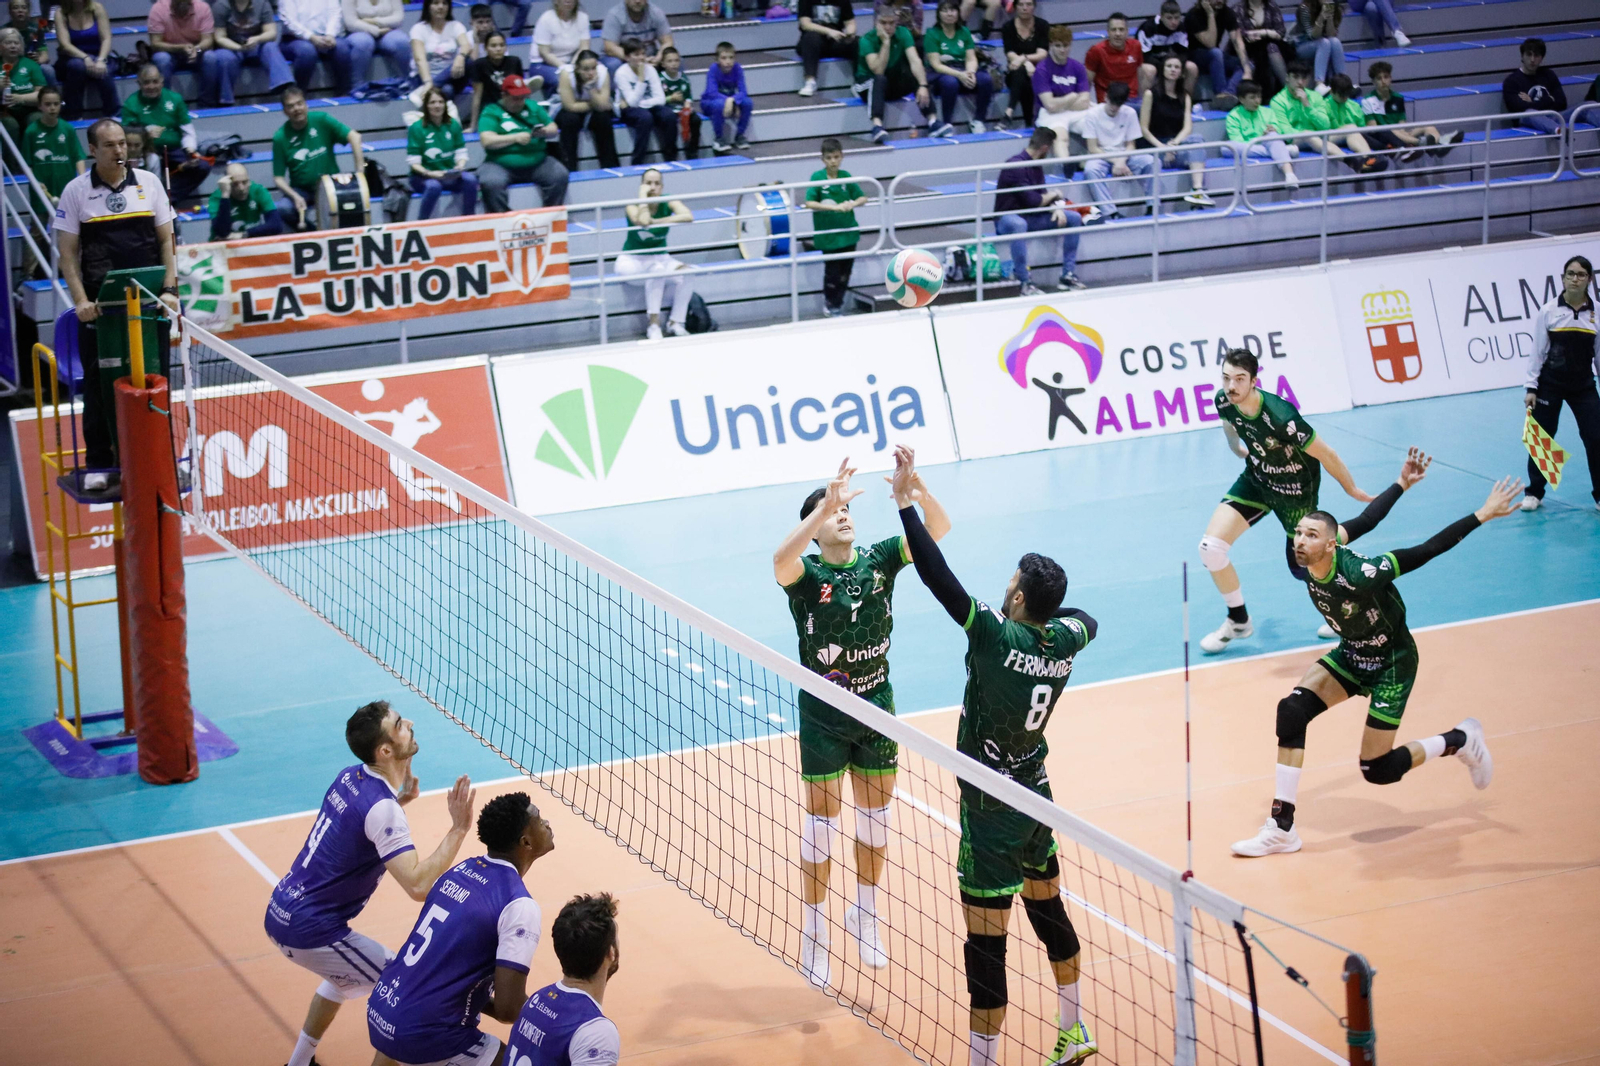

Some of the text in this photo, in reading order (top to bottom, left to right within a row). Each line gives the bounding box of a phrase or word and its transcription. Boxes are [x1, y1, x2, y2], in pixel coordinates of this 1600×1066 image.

[293, 226, 431, 276] PEÑA
[241, 263, 488, 324] LA UNION
[1467, 331, 1534, 364] CIUD
[670, 374, 926, 456] Unicaja
[284, 487, 389, 523] MASCULINA
[851, 601, 863, 623] 7
[1024, 684, 1053, 732] 8
[301, 811, 333, 869] 4
[439, 879, 471, 904] SERRANO
[461, 867, 489, 885] LÉLEMAN
[403, 903, 450, 968] 5
[369, 1006, 396, 1035] HYUNDAI
[536, 1001, 559, 1020] LÉLEMAN
